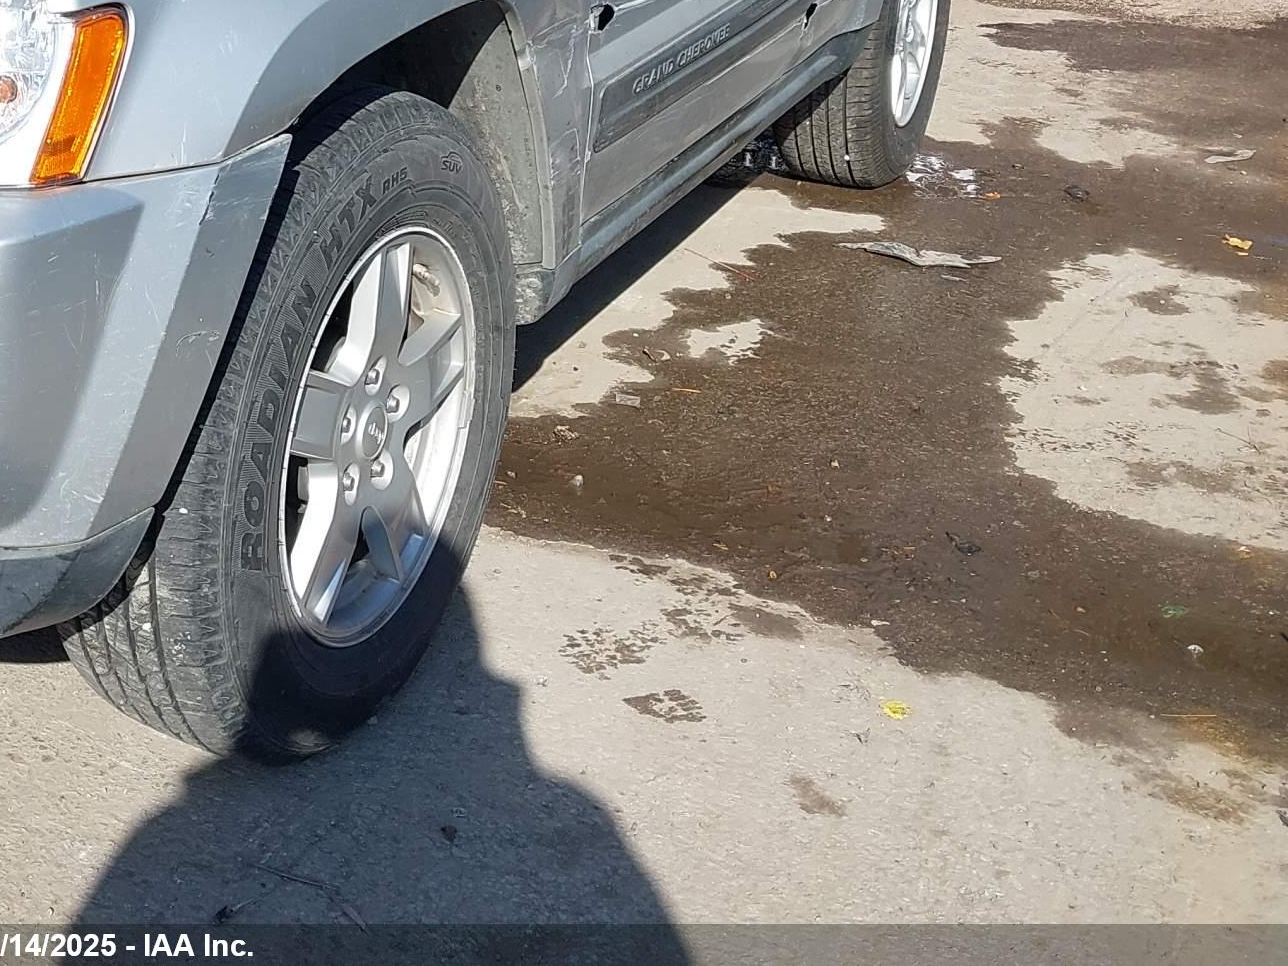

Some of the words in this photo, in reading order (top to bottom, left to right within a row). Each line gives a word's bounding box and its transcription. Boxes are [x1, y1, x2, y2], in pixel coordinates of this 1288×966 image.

[632, 58, 674, 95] GRAND
[440, 159, 462, 175] SUV
[240, 280, 317, 571] ROADIAN
[319, 174, 378, 271] HTX
